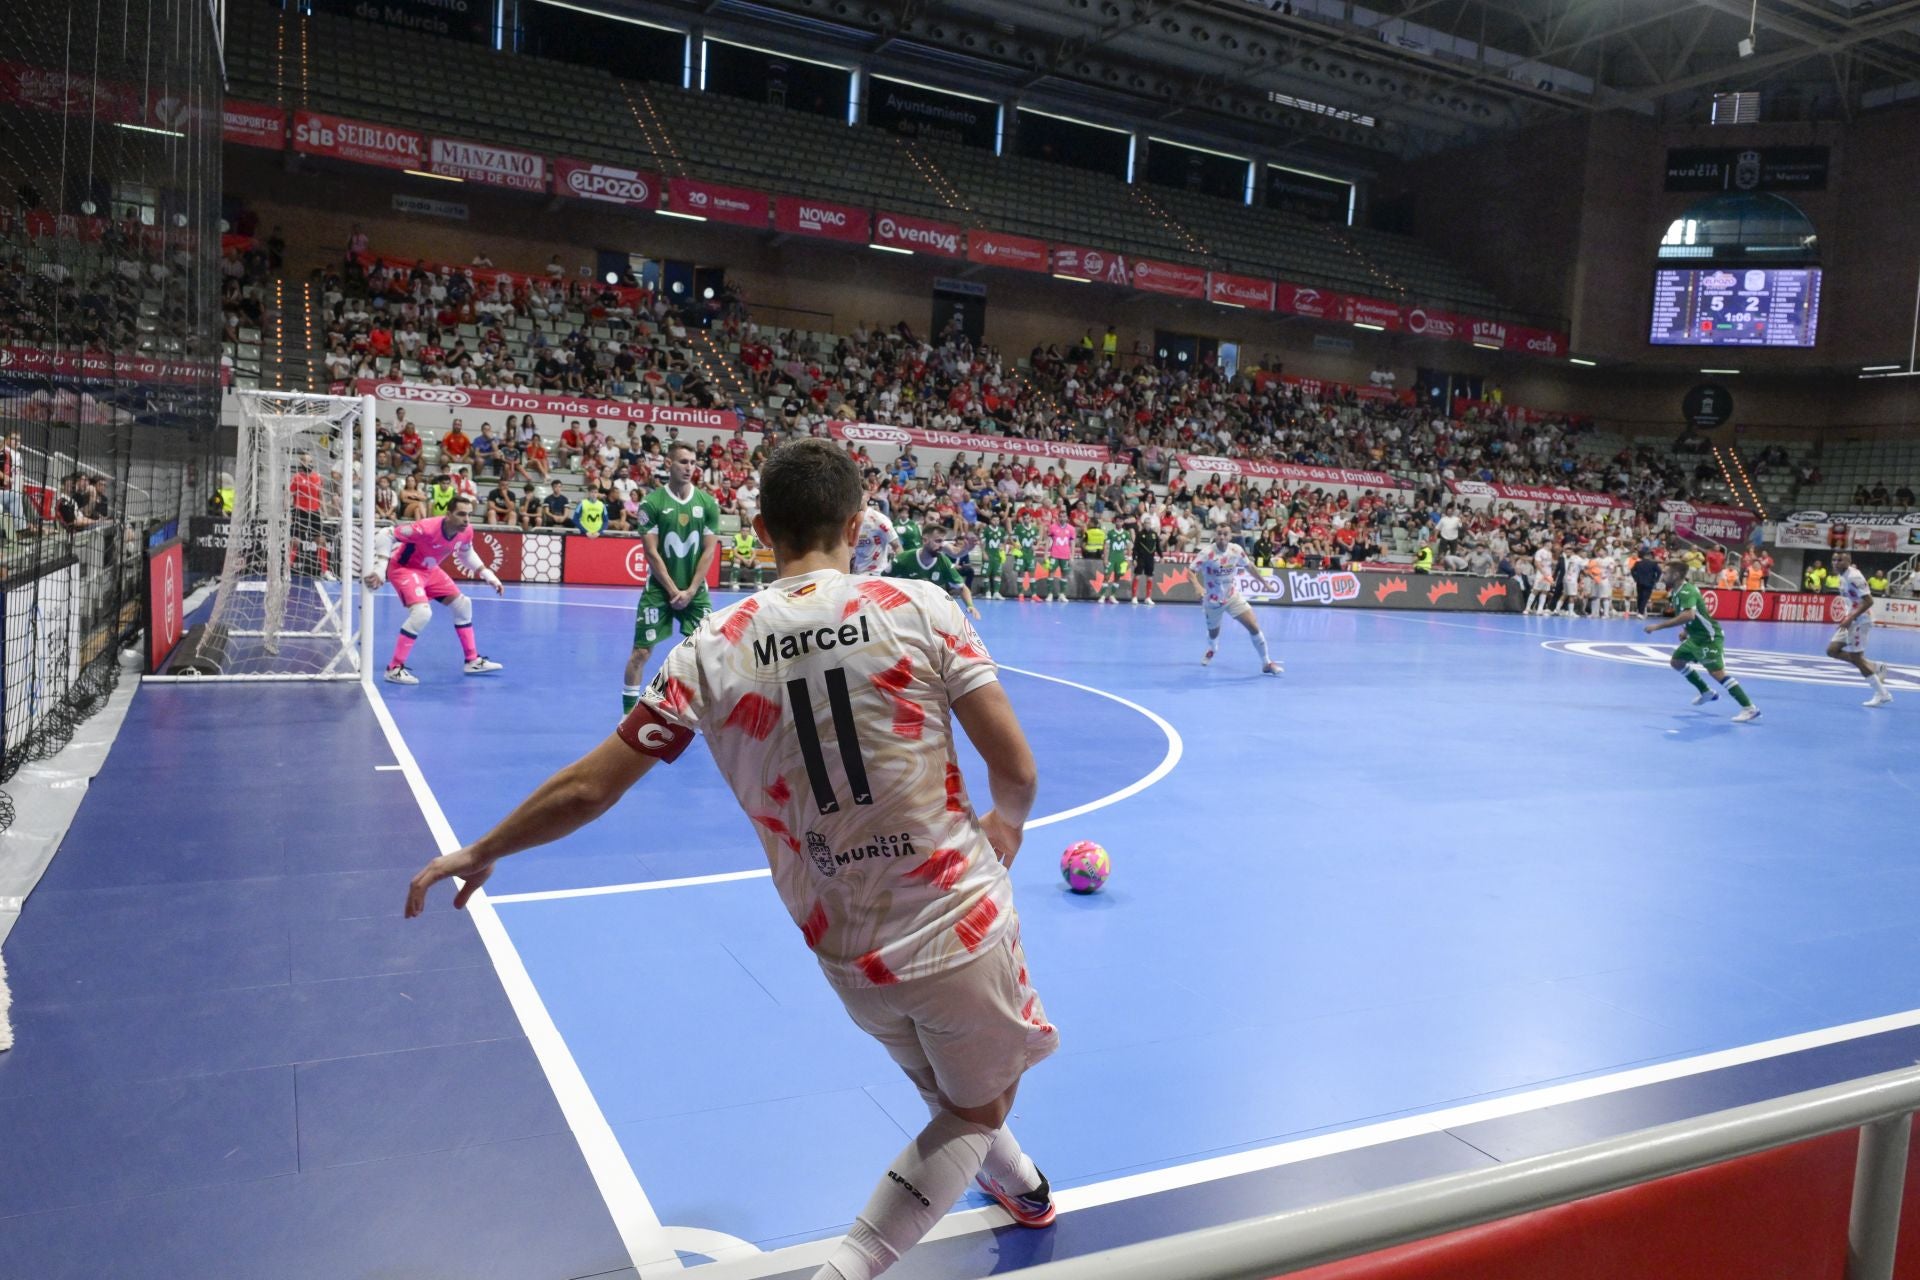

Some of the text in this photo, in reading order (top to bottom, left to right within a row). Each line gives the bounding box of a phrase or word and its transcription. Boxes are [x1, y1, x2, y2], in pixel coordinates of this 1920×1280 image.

[384, 6, 448, 33] Murcia
[886, 93, 977, 124] Ayuntamiento
[337, 123, 419, 155] SEIBLOCK
[442, 142, 534, 175] MANZANO
[432, 163, 542, 189] ACEITES DE OLIVA
[800, 207, 846, 226] NOVAC
[898, 226, 958, 252] venty4
[1711, 296, 1759, 311] 5 2
[1724, 312, 1751, 322] 1:06
[1473, 322, 1506, 339] UCAM
[491, 394, 539, 409] Uno
[547, 400, 589, 414] más
[597, 404, 620, 417] de
[627, 406, 645, 419] la
[651, 407, 722, 425] familia
[924, 431, 961, 446] Uno
[967, 437, 999, 449] más
[1003, 440, 1022, 451] de
[1026, 442, 1040, 453] la
[1044, 442, 1098, 458] familia
[1249, 461, 1279, 474] Uno
[1283, 466, 1308, 477] más
[1311, 469, 1325, 479] de
[1328, 470, 1338, 480] la
[1342, 469, 1384, 484] familia
[1503, 486, 1528, 498] Uno
[1577, 492, 1612, 505] familia
[1826, 516, 1895, 527] COMPARTIR
[1780, 594, 1825, 604] DIVISIÓN
[1778, 604, 1825, 621] FÚTBOL SALA
[753, 615, 870, 668] Marcel
[787, 667, 873, 816] 11
[835, 843, 917, 866] MURCIA
